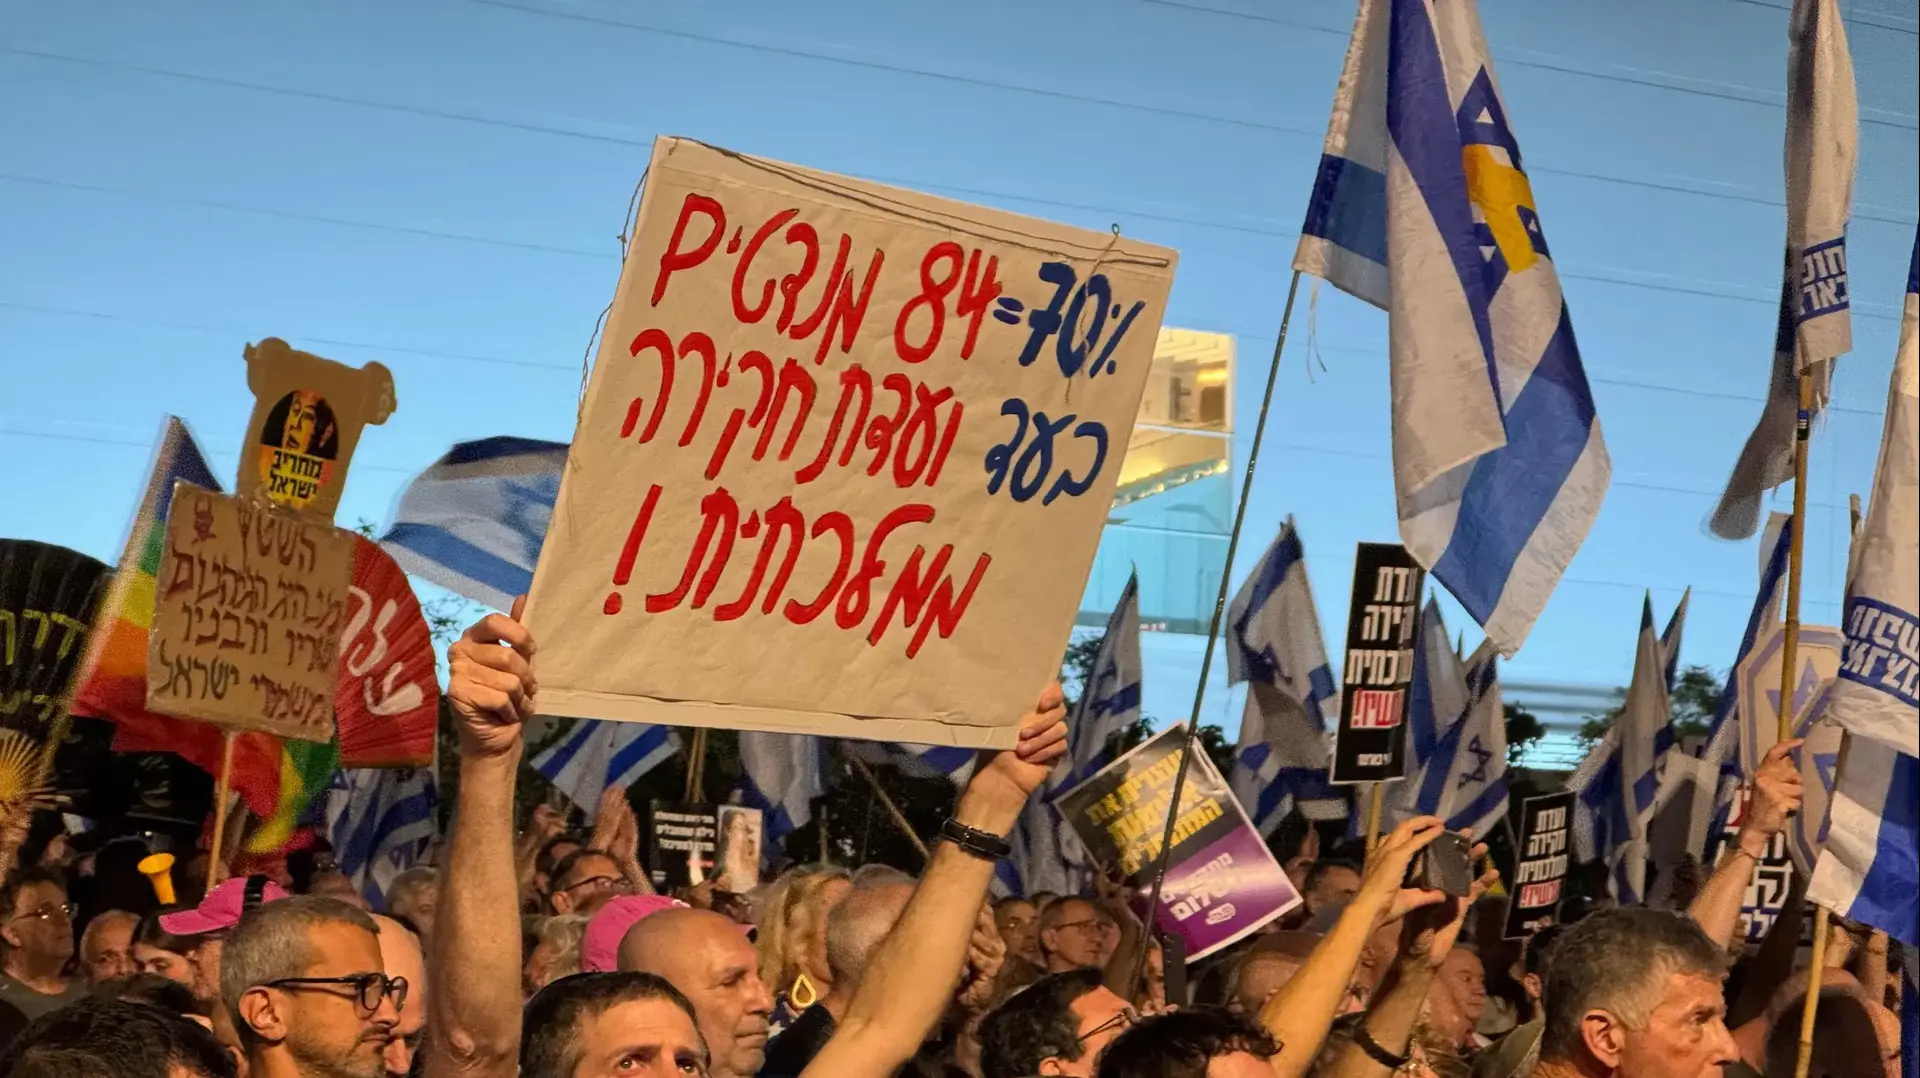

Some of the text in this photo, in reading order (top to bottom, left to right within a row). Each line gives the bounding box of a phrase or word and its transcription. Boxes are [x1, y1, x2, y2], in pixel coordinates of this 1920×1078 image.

[651, 193, 884, 366] מנדטים
[620, 328, 1110, 506] בעד ועדת חקירה
[269, 469, 318, 499] ישראל
[272, 450, 323, 478] מחריב
[181, 603, 268, 654] ורבניו
[152, 639, 240, 700] ישראל
